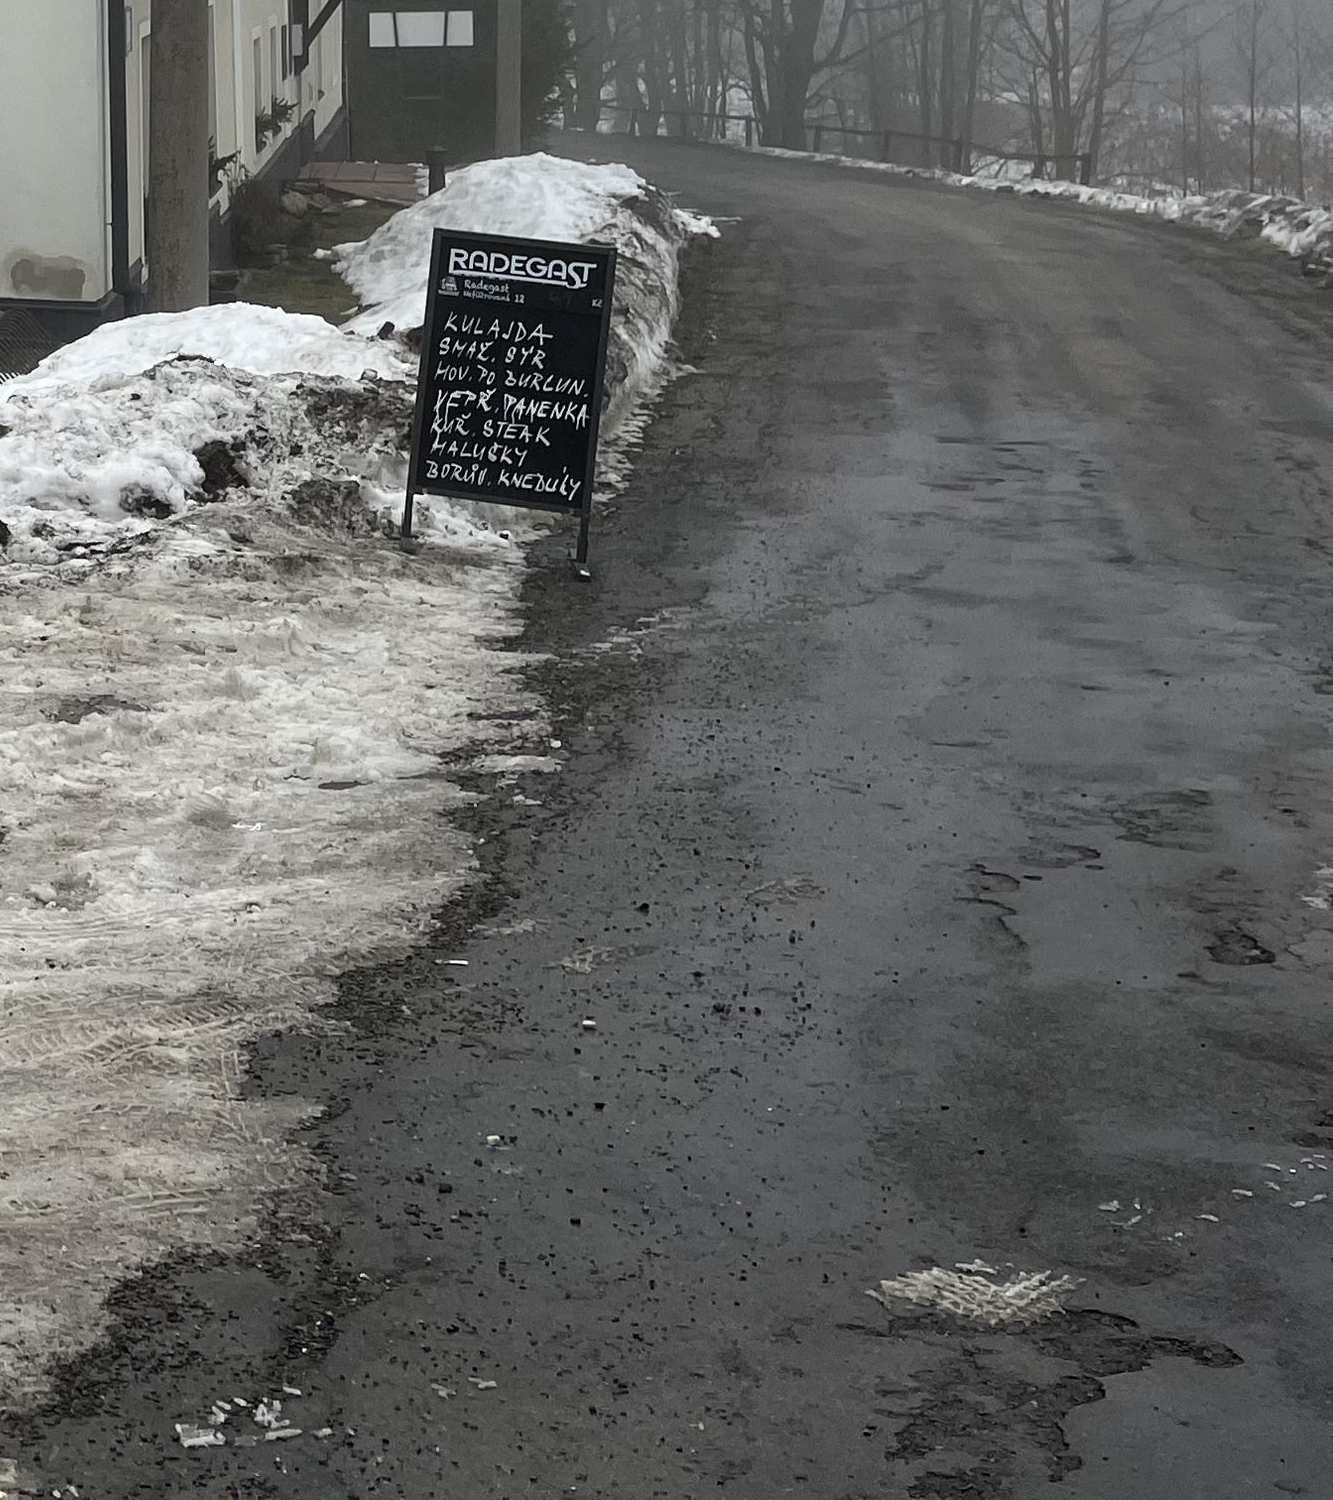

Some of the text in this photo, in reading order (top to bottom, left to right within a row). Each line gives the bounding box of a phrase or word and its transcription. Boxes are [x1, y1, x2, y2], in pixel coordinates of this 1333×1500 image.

[449, 248, 597, 289] RADEGAST
[464, 279, 509, 294] Radegast
[514, 294, 525, 304] 12
[444, 311, 554, 346] KULAJDA
[477, 365, 496, 385] PO
[503, 393, 589, 430] PANENKA
[483, 419, 550, 447] STEAK
